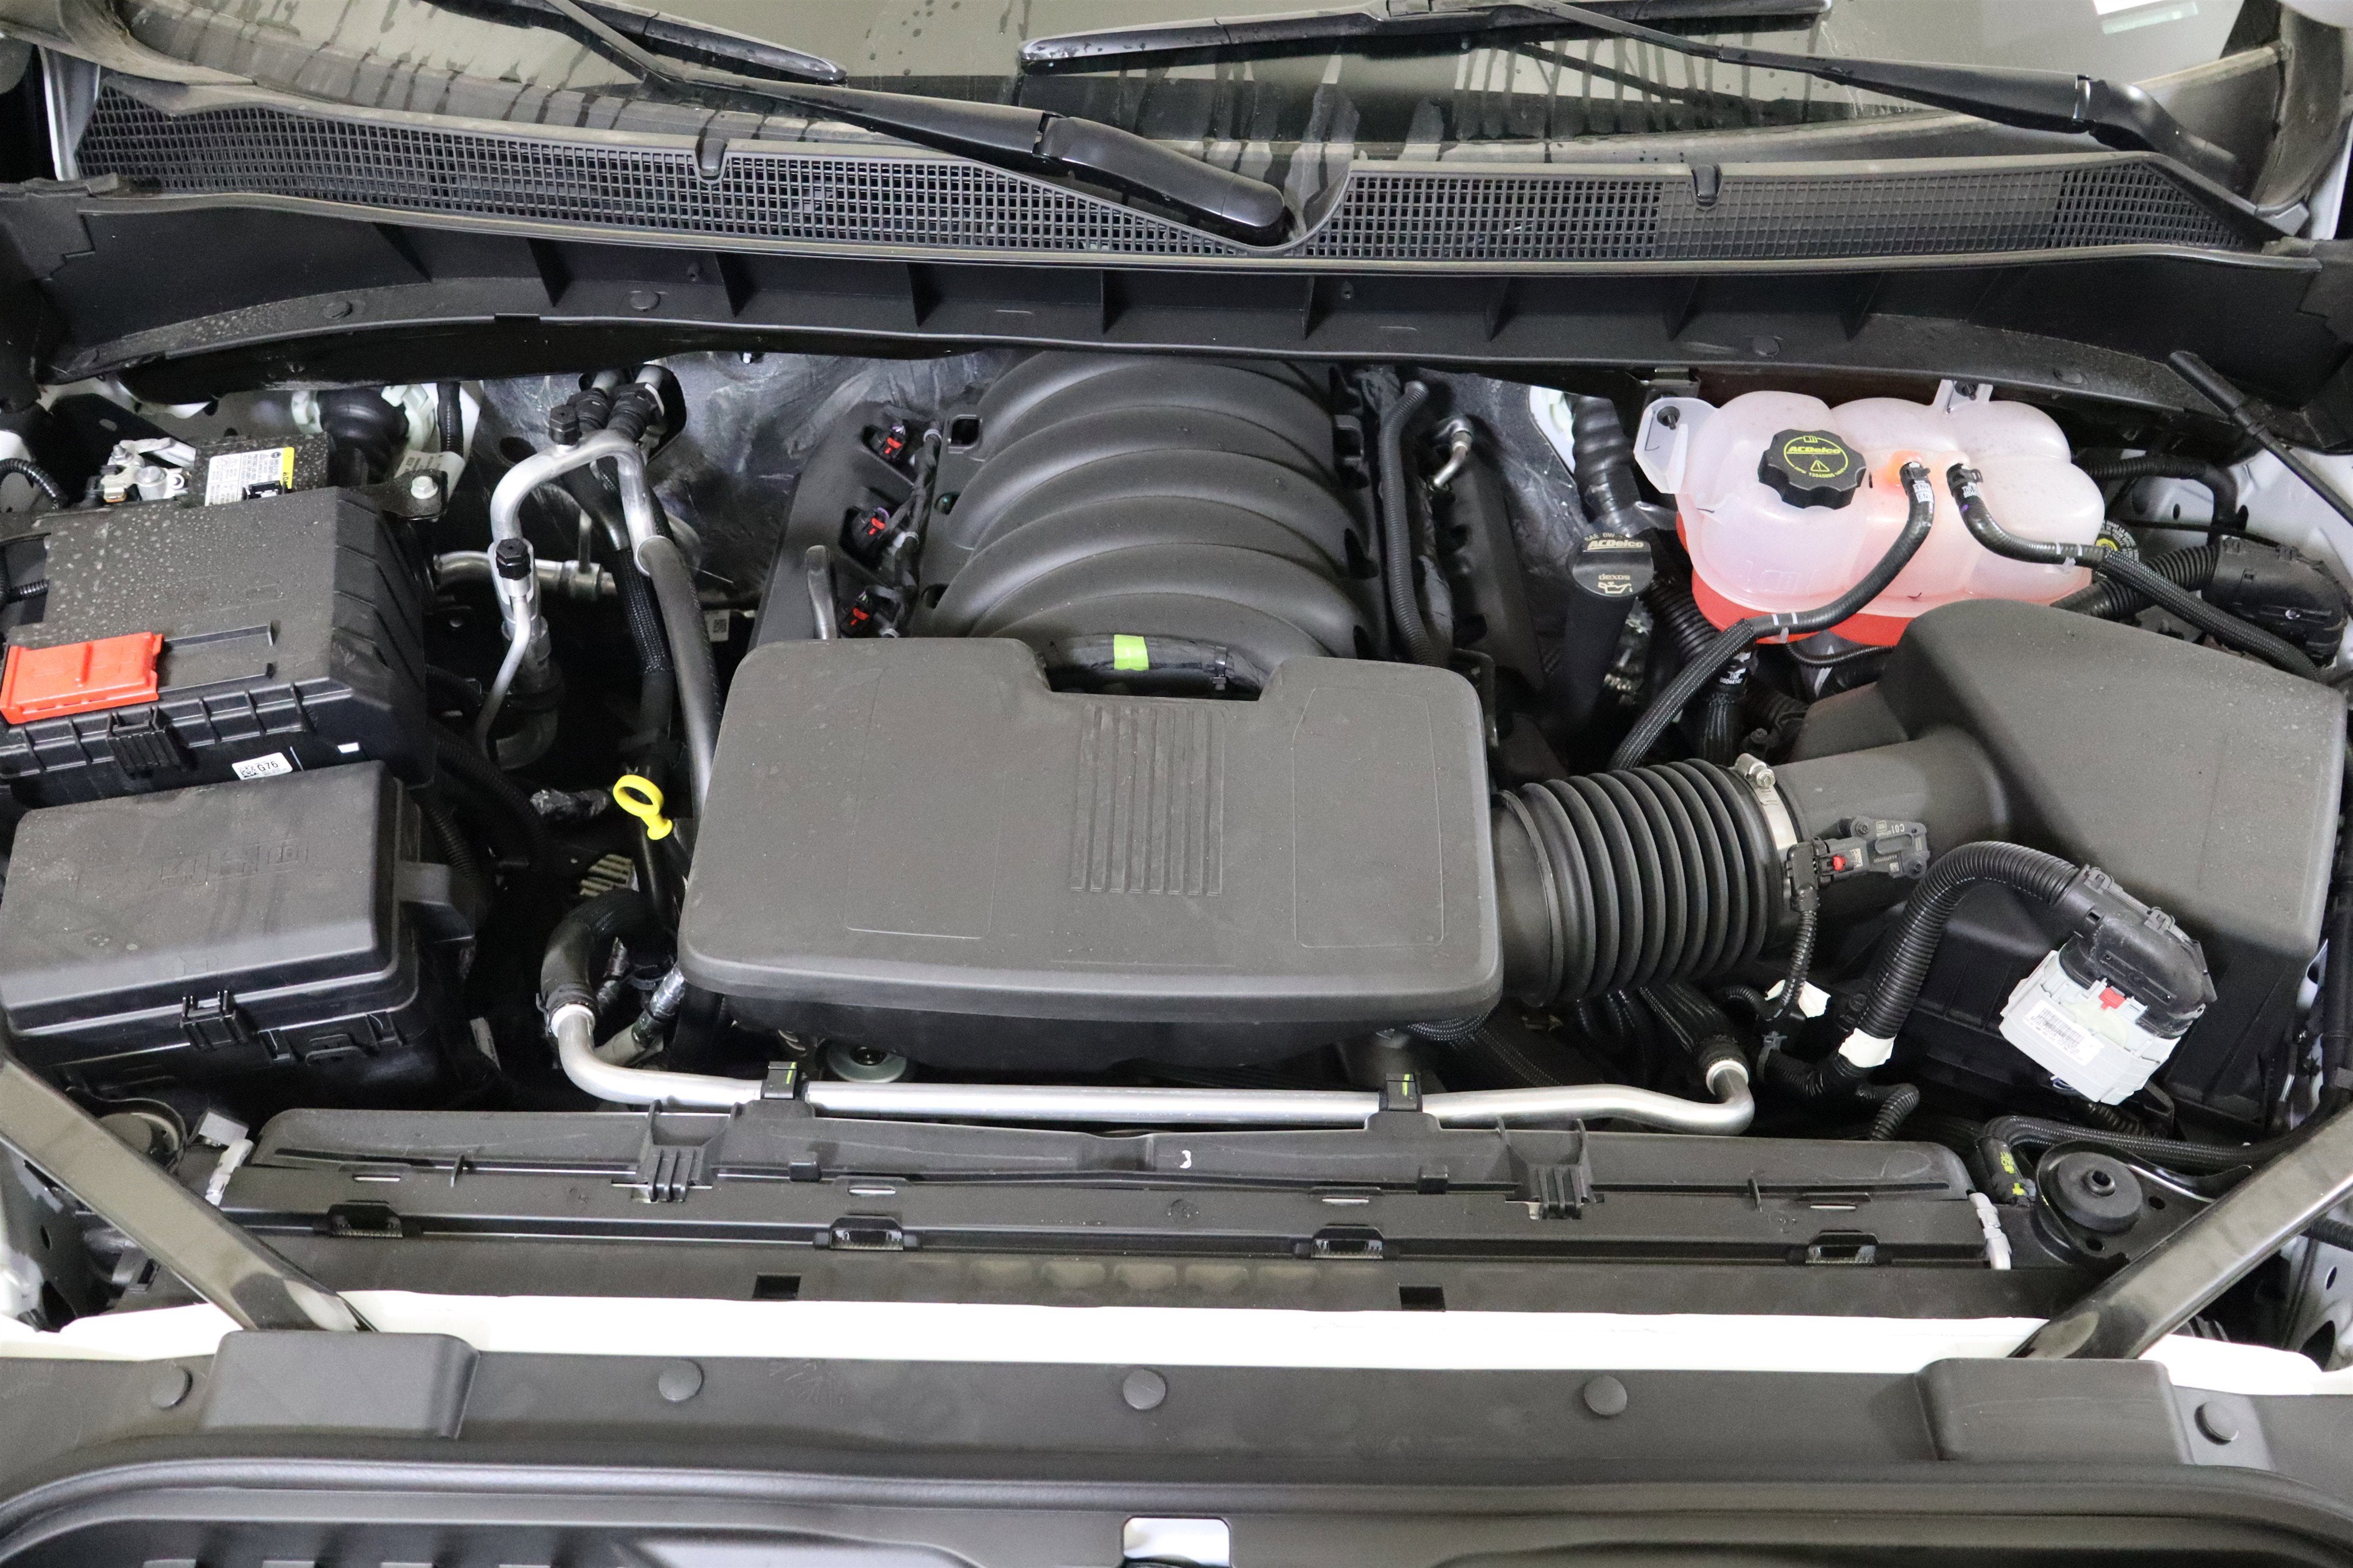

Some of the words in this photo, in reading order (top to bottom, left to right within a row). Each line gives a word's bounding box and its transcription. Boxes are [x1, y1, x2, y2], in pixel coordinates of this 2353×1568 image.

[1584, 533, 1599, 542] SAE
[1587, 540, 1644, 549] ACDelco
[257, 761, 279, 772] G76
[1892, 823, 1905, 834] C01
